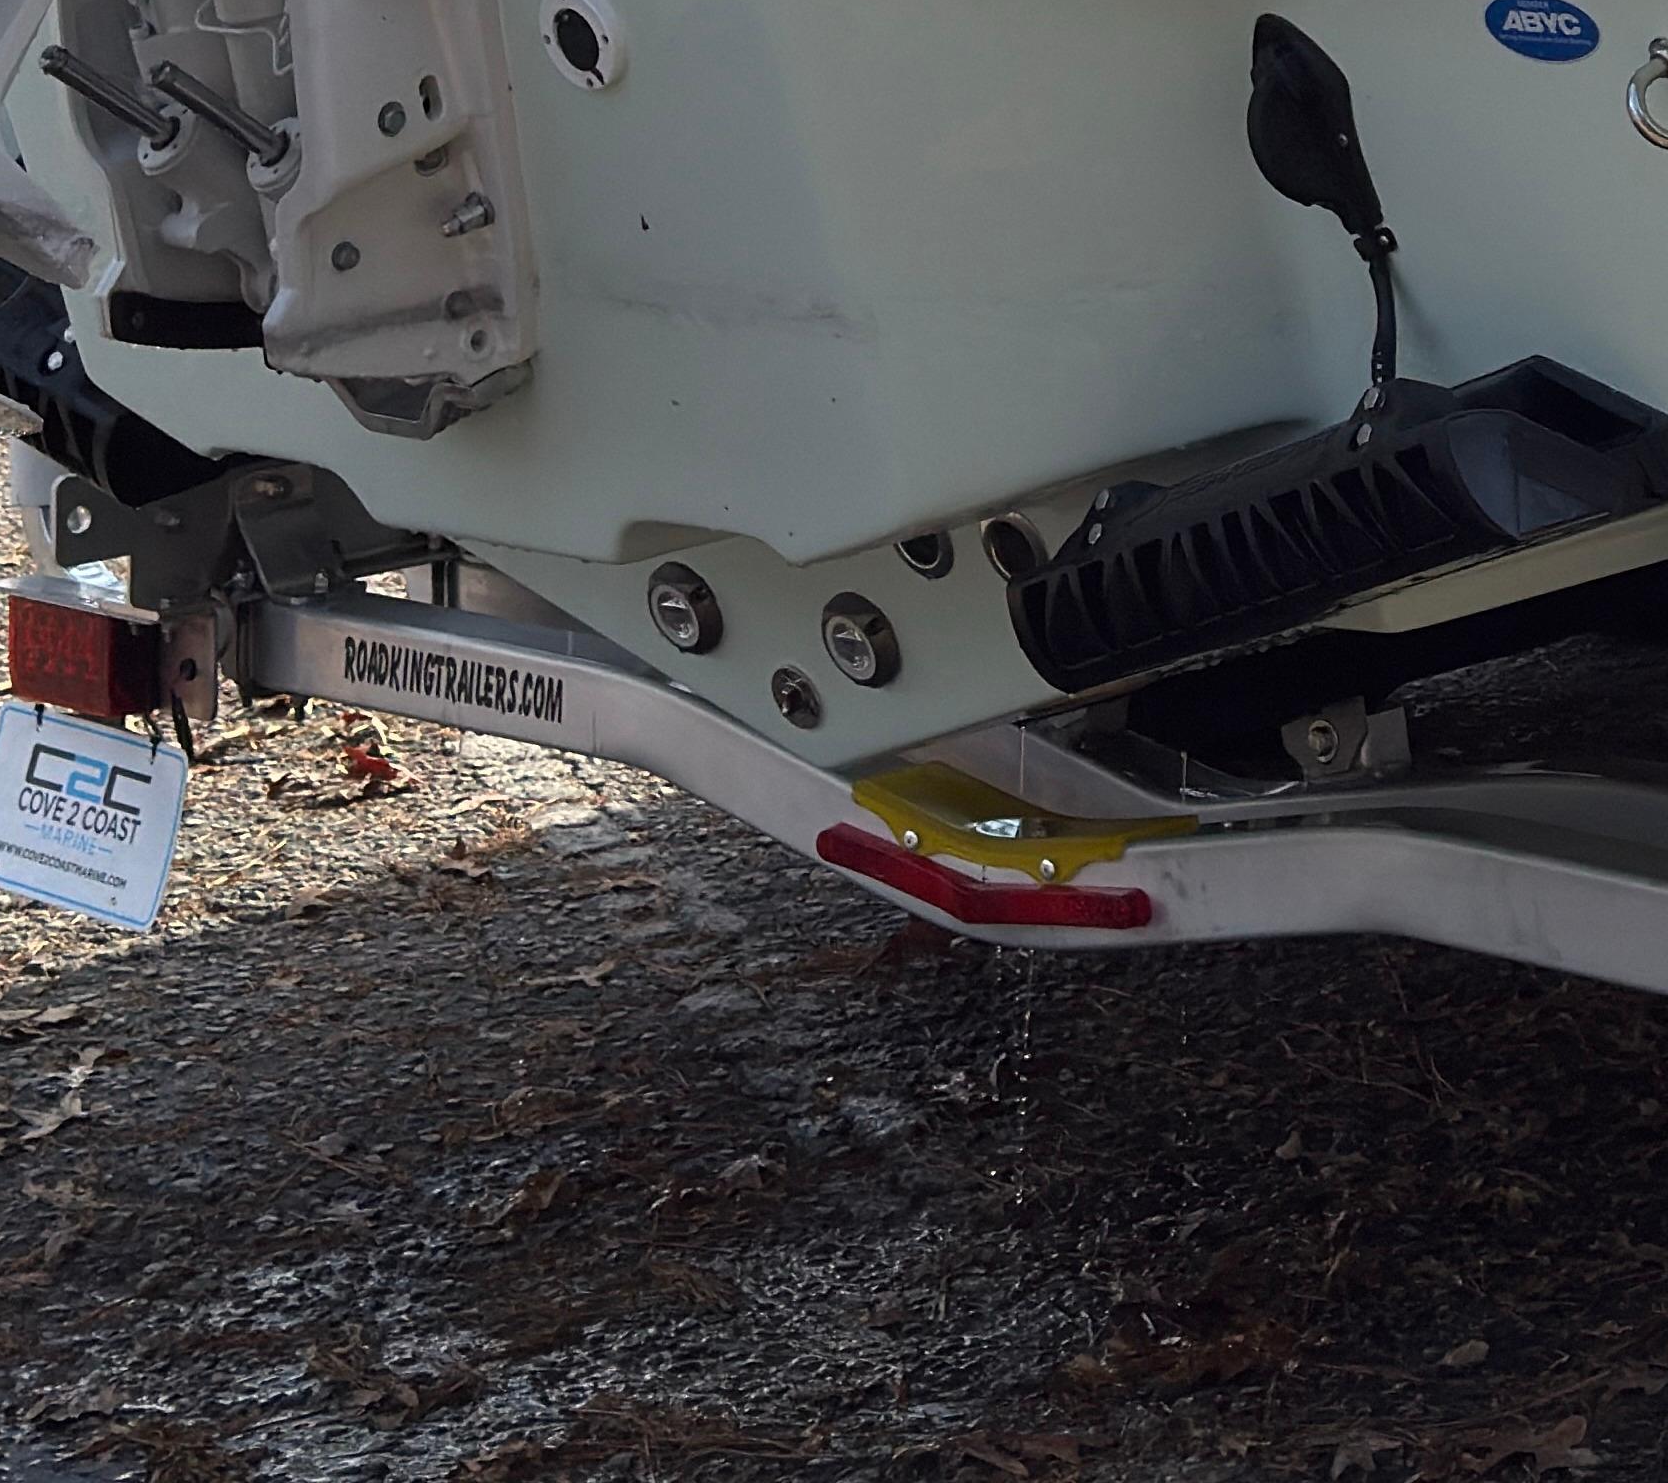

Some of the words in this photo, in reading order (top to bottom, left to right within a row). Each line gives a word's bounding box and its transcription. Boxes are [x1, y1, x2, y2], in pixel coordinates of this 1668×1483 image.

[1502, 9, 1582, 36] ABYC
[343, 635, 564, 724] ROADKINGTRAILERS.COM
[25, 742, 152, 816] C2C
[18, 787, 67, 823] COVE
[65, 802, 81, 827] 2
[82, 805, 142, 846] COAST
[40, 822, 98, 856] MARINE
